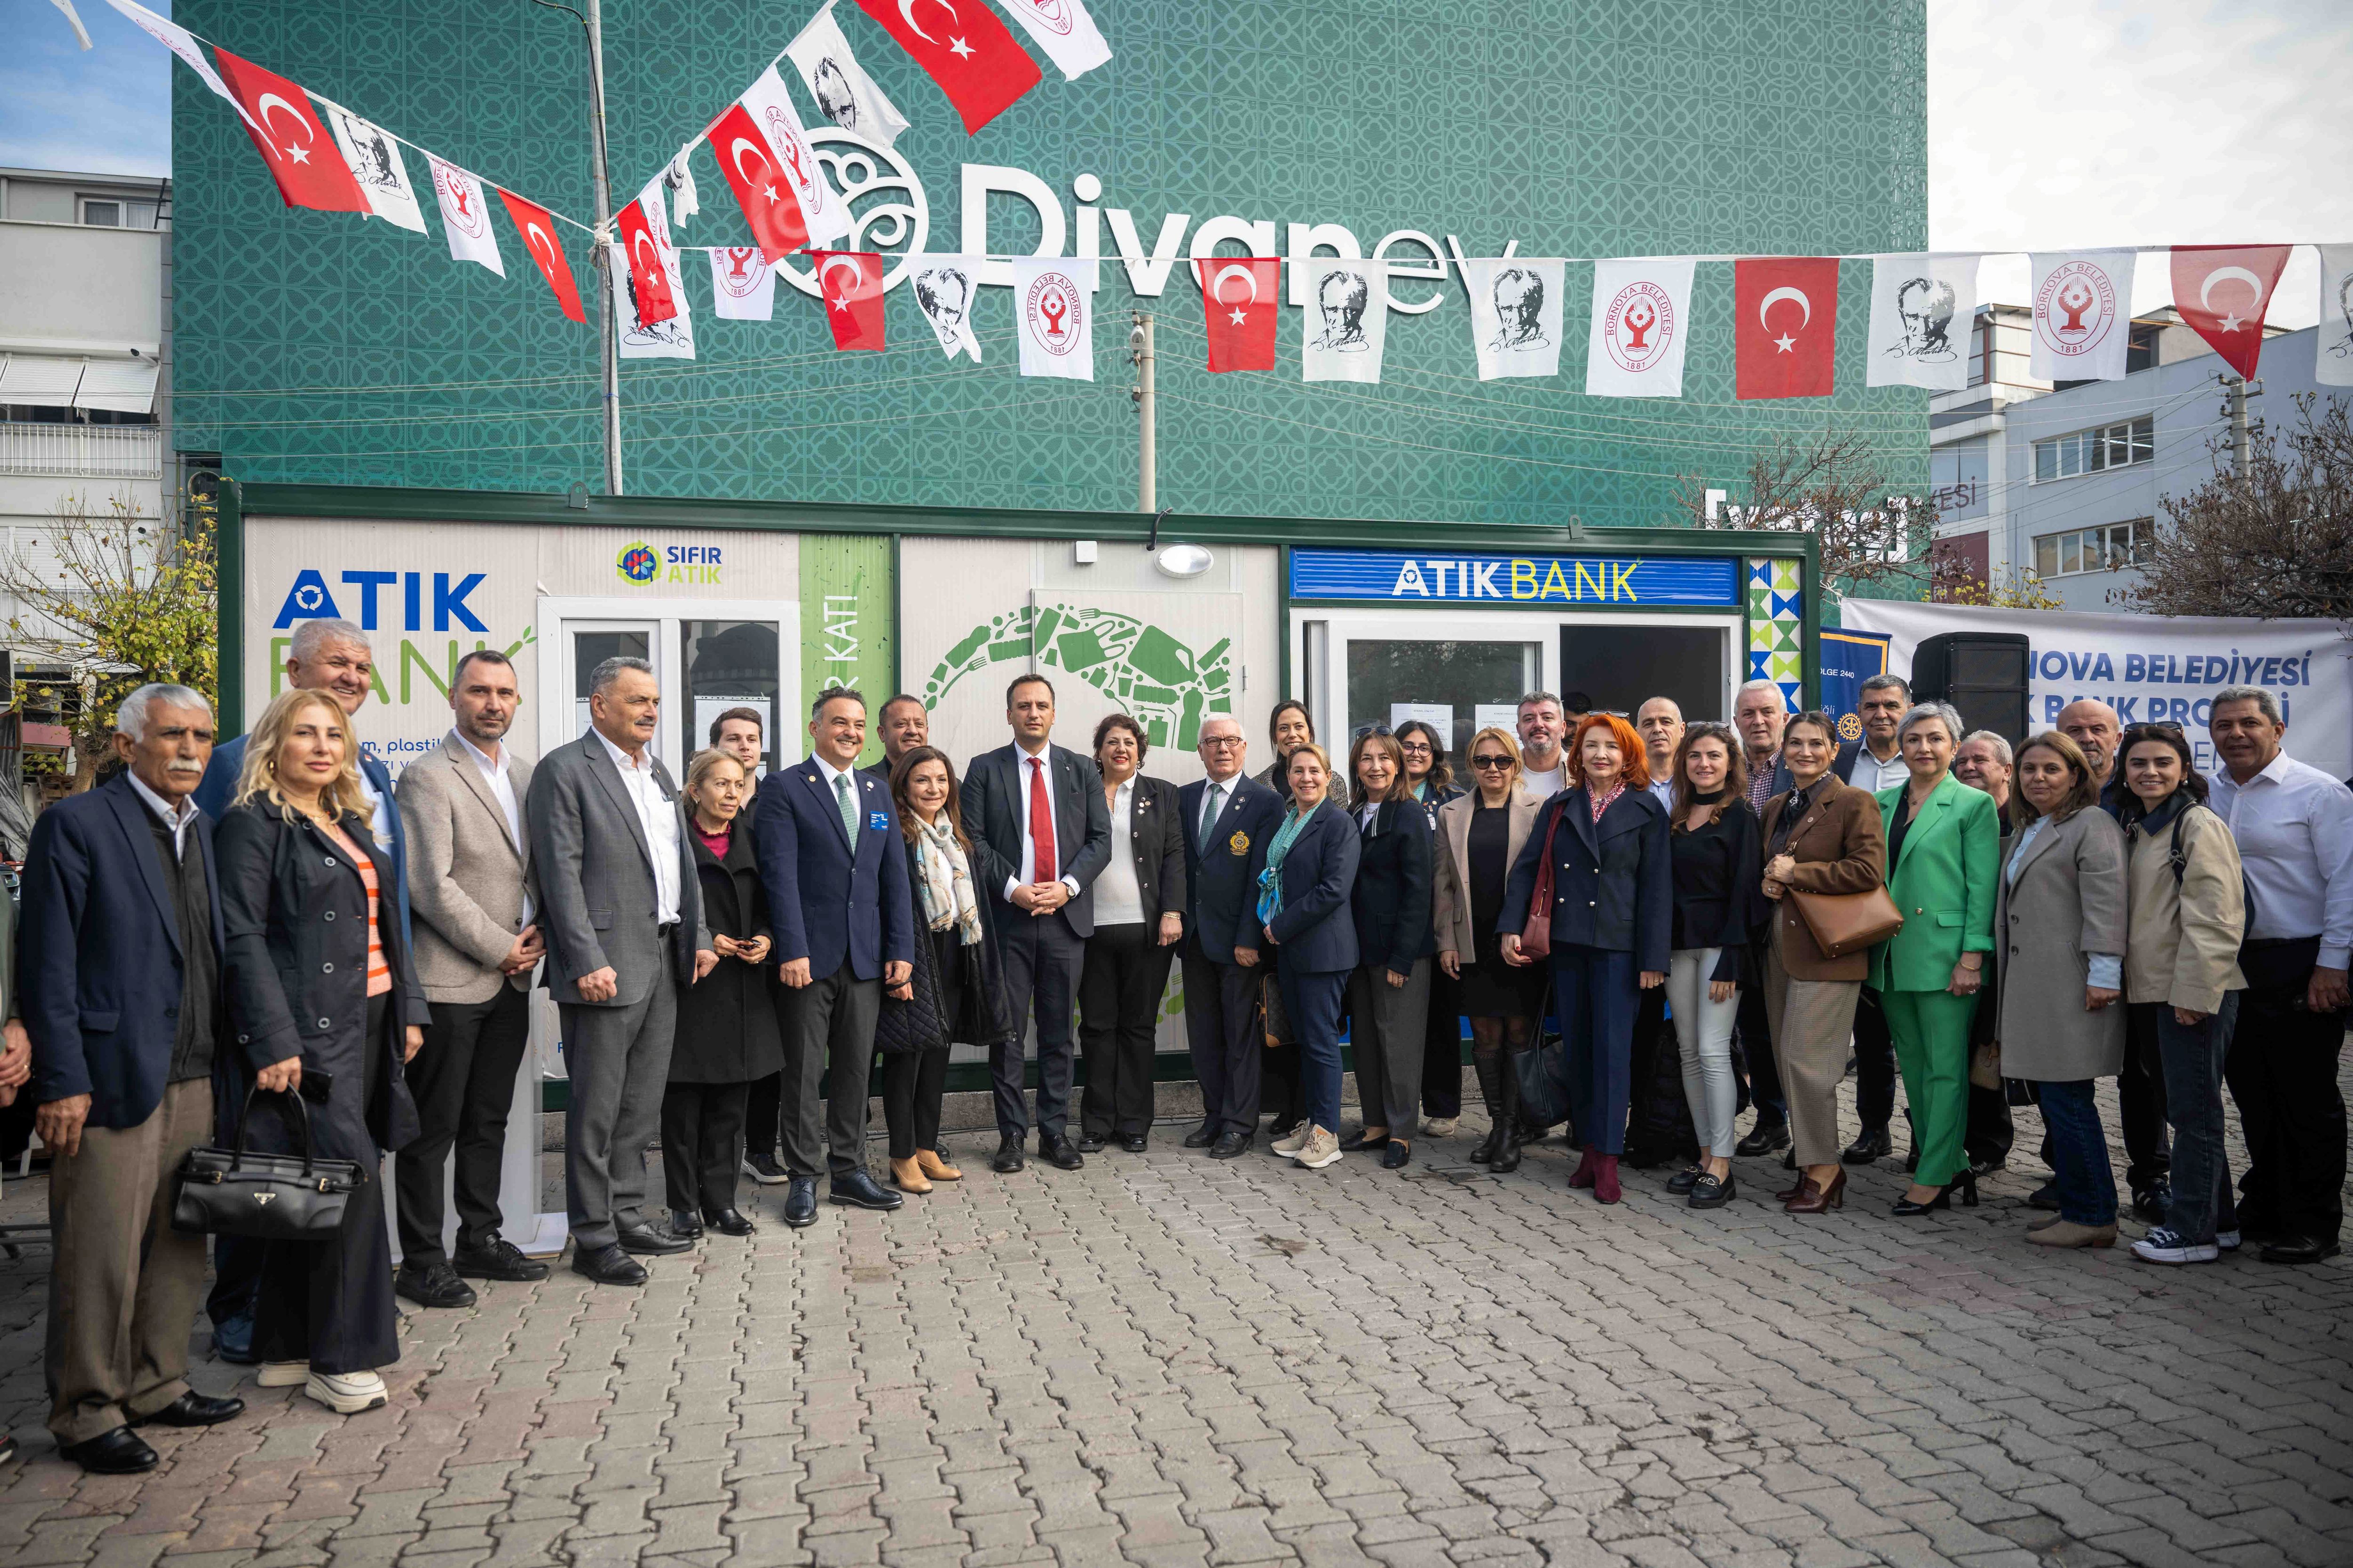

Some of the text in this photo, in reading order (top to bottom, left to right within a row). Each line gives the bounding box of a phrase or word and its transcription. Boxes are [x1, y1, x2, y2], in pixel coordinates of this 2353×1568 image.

[2038, 264, 2113, 318] BORNOVA BELEDİYESİ
[1607, 284, 1671, 336] BORNOVA BELEDİYESİ
[2061, 345, 2082, 353] 1881
[1627, 361, 1645, 369] 1881
[667, 546, 722, 564] SIFIR
[667, 565, 723, 584] ATIK
[272, 569, 490, 632] ATIK
[1840, 670, 1855, 679] 2440
[2124, 648, 2313, 686] BELEDİYESİ
